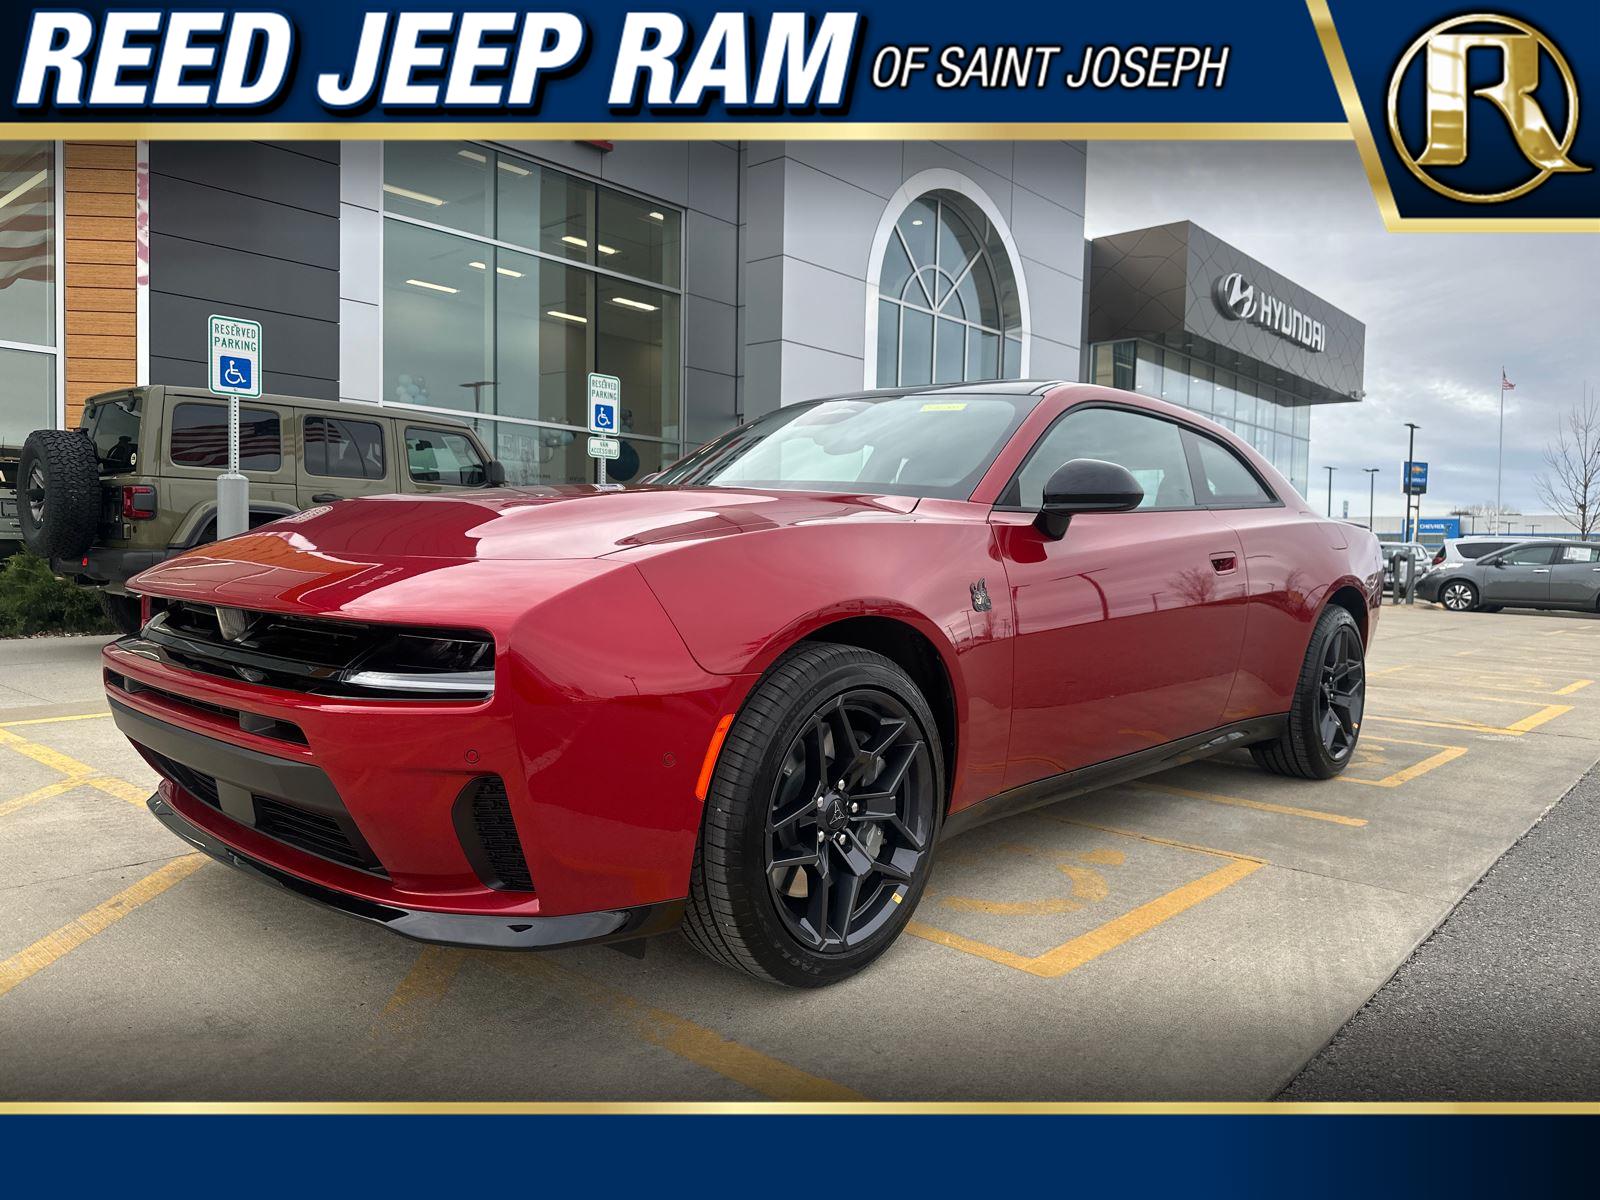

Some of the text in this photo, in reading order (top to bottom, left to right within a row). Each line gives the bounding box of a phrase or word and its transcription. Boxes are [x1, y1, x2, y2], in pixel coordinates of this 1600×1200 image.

[1260, 292, 1325, 352] HYUNDAI
[214, 323, 256, 339] RESERVED
[214, 336, 257, 351] PARKING
[591, 379, 617, 391] RESERVED
[592, 389, 617, 400] PARKING
[590, 447, 617, 456] ACCESSIBLE
